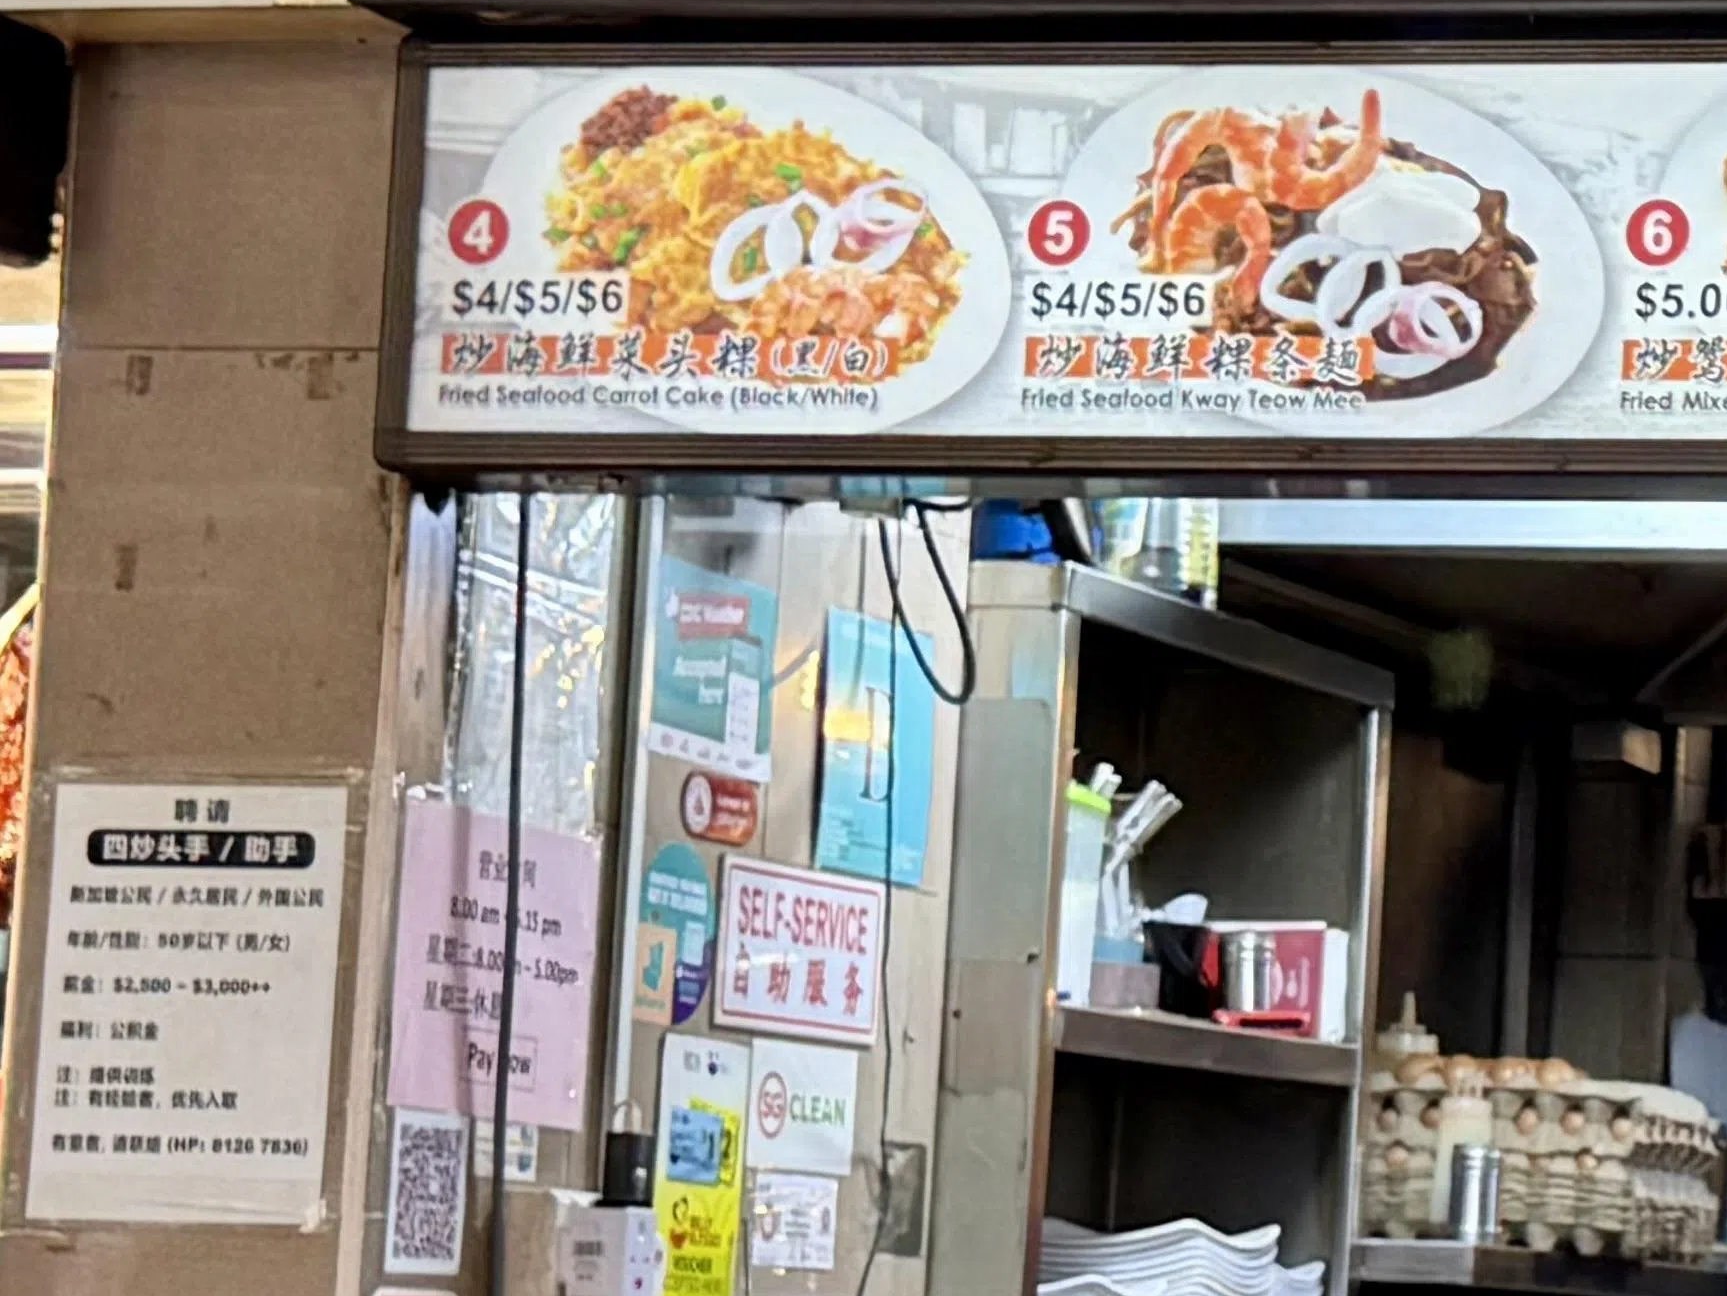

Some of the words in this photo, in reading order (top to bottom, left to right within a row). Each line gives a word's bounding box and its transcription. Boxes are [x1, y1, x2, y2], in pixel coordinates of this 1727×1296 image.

[463, 211, 494, 255] 4
[1044, 210, 1074, 255] 5
[1641, 211, 1674, 255] 6
[452, 279, 623, 322] $4/$5/$6
[1031, 281, 1206, 320] $4/$5/$6
[439, 385, 490, 404] Fried
[496, 384, 584, 404] Seafood
[598, 385, 658, 404] Carrot
[665, 385, 724, 404] Cake
[730, 384, 878, 409] (Black/White)
[1022, 388, 1073, 408] Fried
[1081, 387, 1173, 408] Seafood
[1182, 389, 1242, 413] Kway
[1250, 389, 1306, 408] Teow
[1313, 389, 1363, 408] Mee
[1620, 392, 1674, 411] Fried
[479, 850, 537, 889] 营业间
[541, 918, 562, 940] pm
[738, 884, 869, 956] SELF-SERVICE
[733, 940, 864, 1017] 自助服务
[762, 1091, 783, 1119] SG
[791, 1094, 847, 1126] CLEAN
